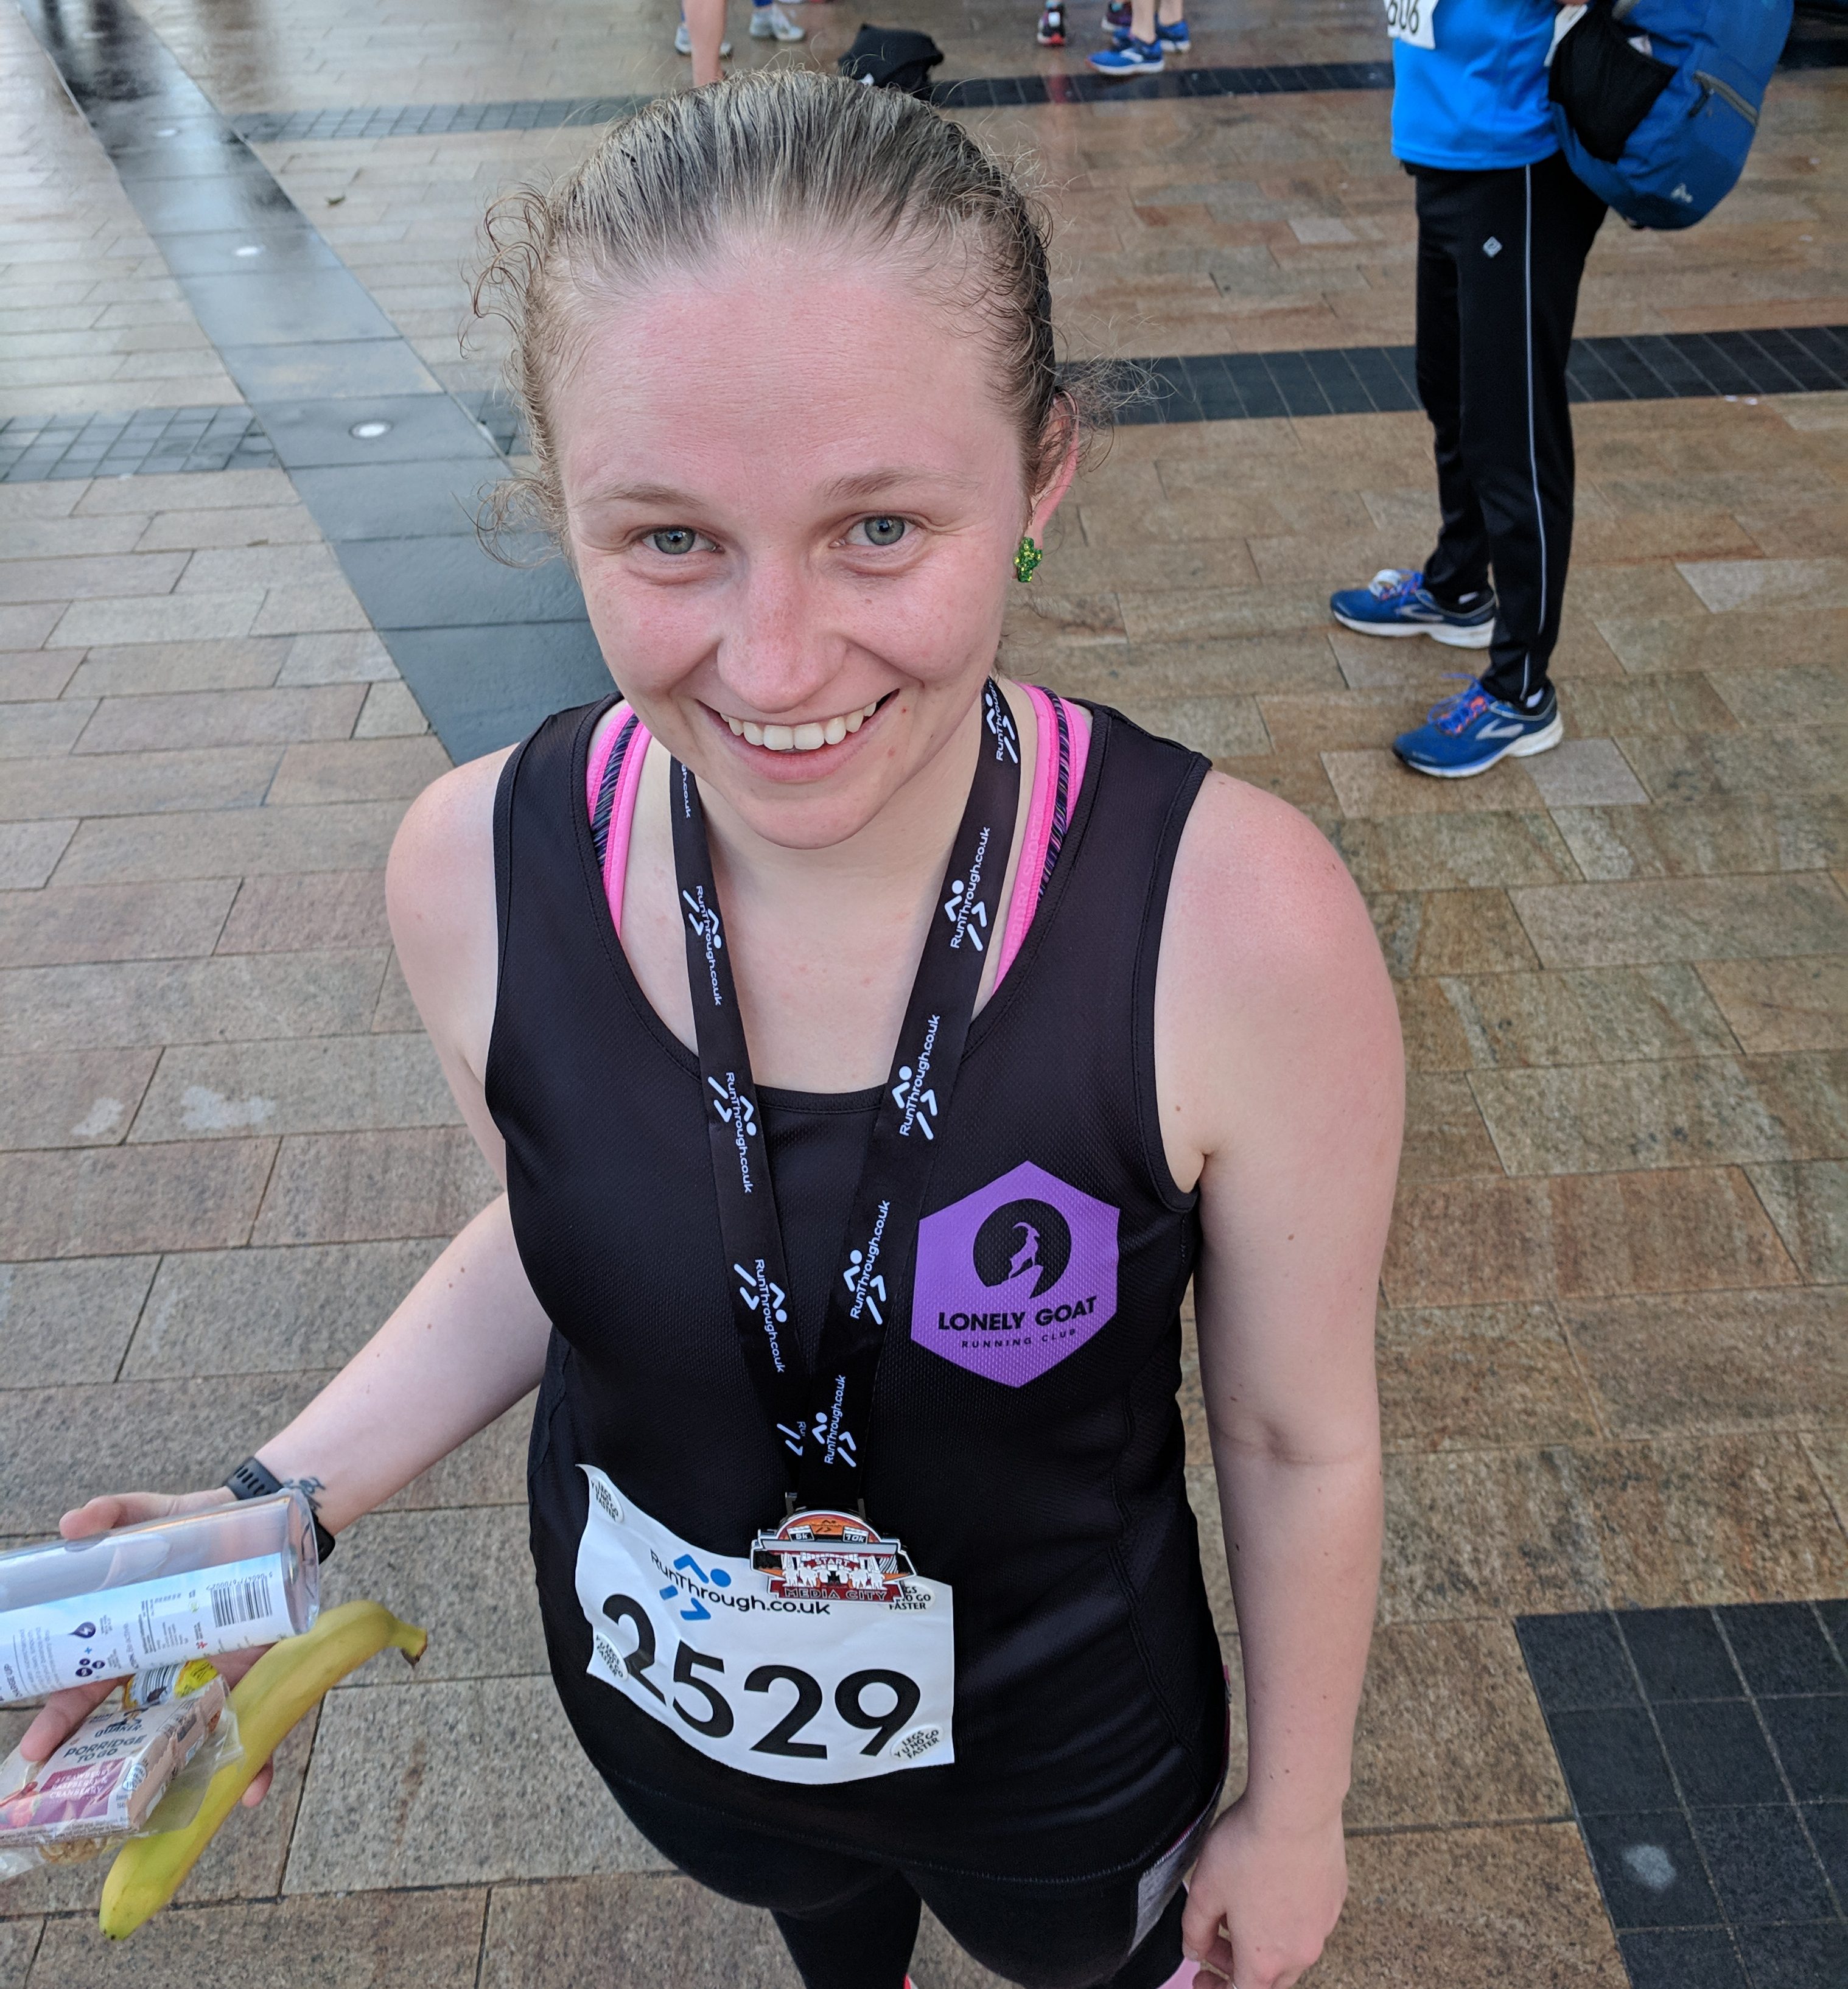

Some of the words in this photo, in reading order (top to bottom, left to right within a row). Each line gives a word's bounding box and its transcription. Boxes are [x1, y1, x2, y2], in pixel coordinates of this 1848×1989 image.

[950, 827, 991, 948] RunThrough.co.uk
[696, 886, 723, 1005] RunThrough.co.uk
[899, 1014, 940, 1136] RunThrough.co.uk
[726, 1072, 754, 1193] RunThrough.co.uk
[850, 1200, 891, 1320] RunThrough.co.uk
[755, 1259, 786, 1372] RunThrough.co.uk
[938, 1312, 1026, 1331] LONELY
[1035, 1295, 1097, 1326] GOAT
[962, 1336, 1032, 1348] RUNNING
[1041, 1328, 1076, 1343] CLUB
[824, 1374, 846, 1464] RunThrough.co.uk
[814, 1557, 850, 1567] START
[650, 1548, 831, 1615] RunThrough.co.uk
[785, 1588, 841, 1599] MEDIA
[845, 1589, 887, 1601] CITY
[601, 1593, 922, 1760] 2529
[63, 1735, 147, 1758] PORRIDGE
[94, 1724, 142, 1738] QUAKER
[902, 1730, 924, 1746] LEGS
[906, 1737, 940, 1759] FASTER
[909, 1738, 925, 1749] NO
[925, 1730, 939, 1739] GO
[77, 1753, 95, 1763] TO
[97, 1749, 118, 1758] GO
